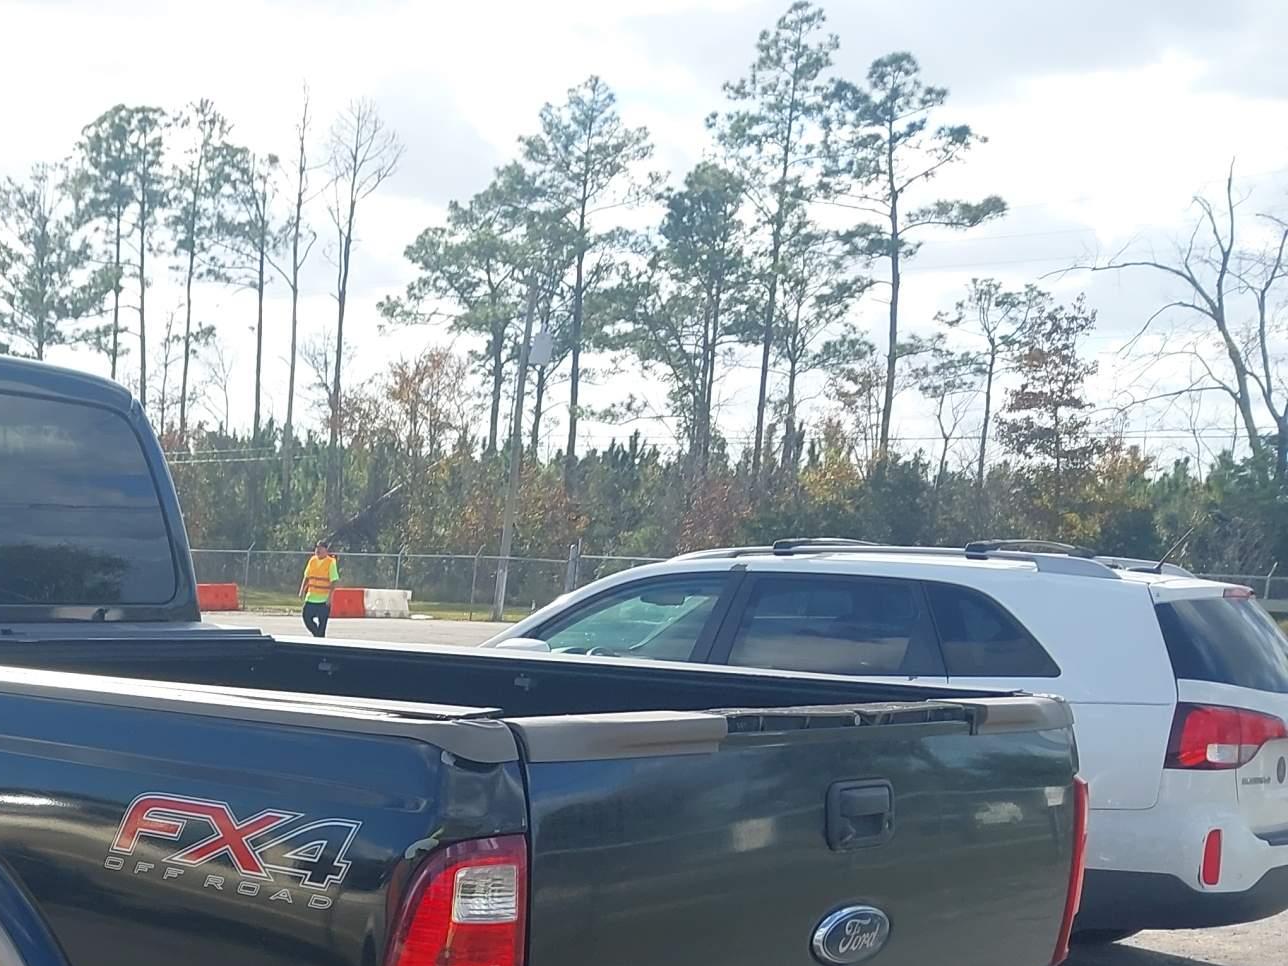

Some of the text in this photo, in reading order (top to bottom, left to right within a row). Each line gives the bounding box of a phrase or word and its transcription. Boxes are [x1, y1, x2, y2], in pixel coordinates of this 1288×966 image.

[109, 792, 362, 891] FX4
[104, 857, 333, 909] OFF ROAD
[839, 918, 880, 953] Ford
